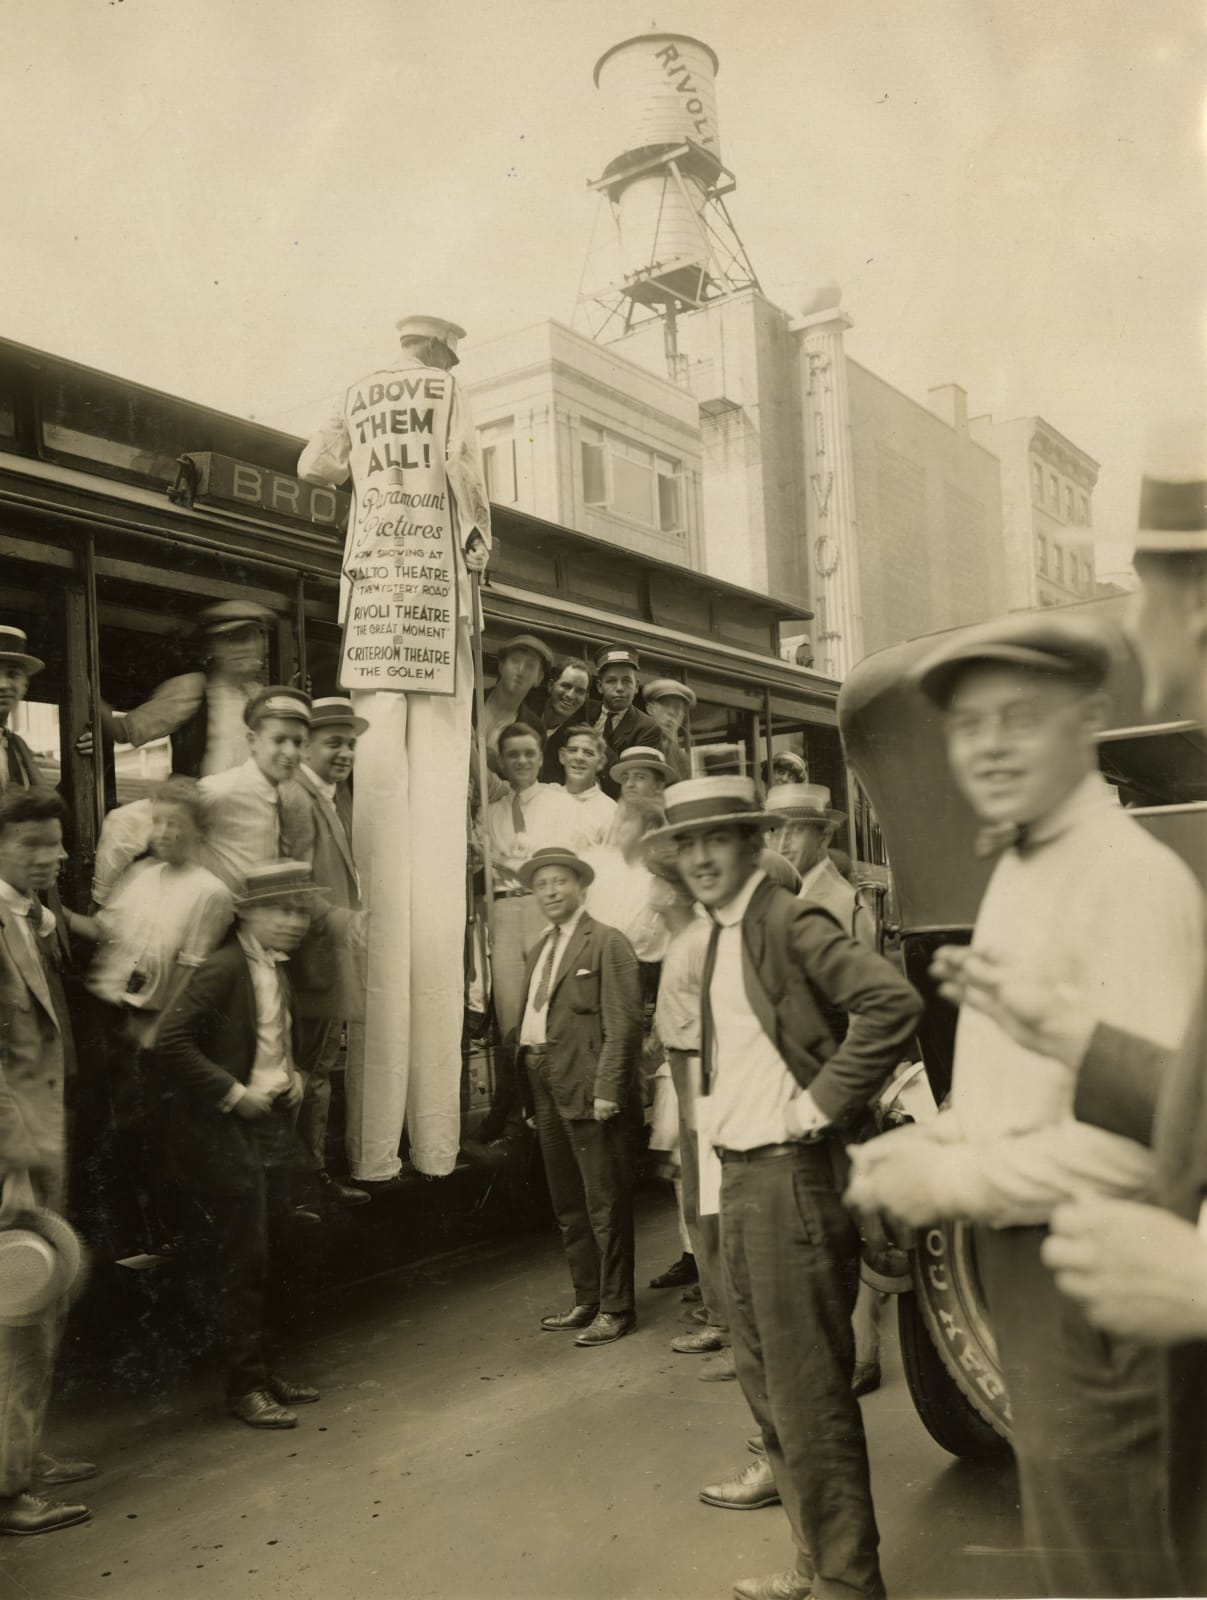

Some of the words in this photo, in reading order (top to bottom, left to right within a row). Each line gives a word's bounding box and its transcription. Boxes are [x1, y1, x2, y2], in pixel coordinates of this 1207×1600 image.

[655, 42, 713, 145] RIVOLI
[351, 378, 445, 416] ABOVE
[356, 408, 434, 444] THEM
[367, 442, 431, 478] ALL!
[358, 487, 446, 524] Paramount
[357, 514, 444, 547] Pictures
[377, 549, 425, 559] SHOWING
[428, 550, 444, 560] AT
[395, 565, 450, 583] THEATRE
[354, 604, 390, 621] RIVOLI
[395, 605, 450, 623] THEATRE
[369, 623, 398, 635] GREAT
[347, 646, 400, 662] CRITERION
[404, 647, 450, 665] THEATRE
